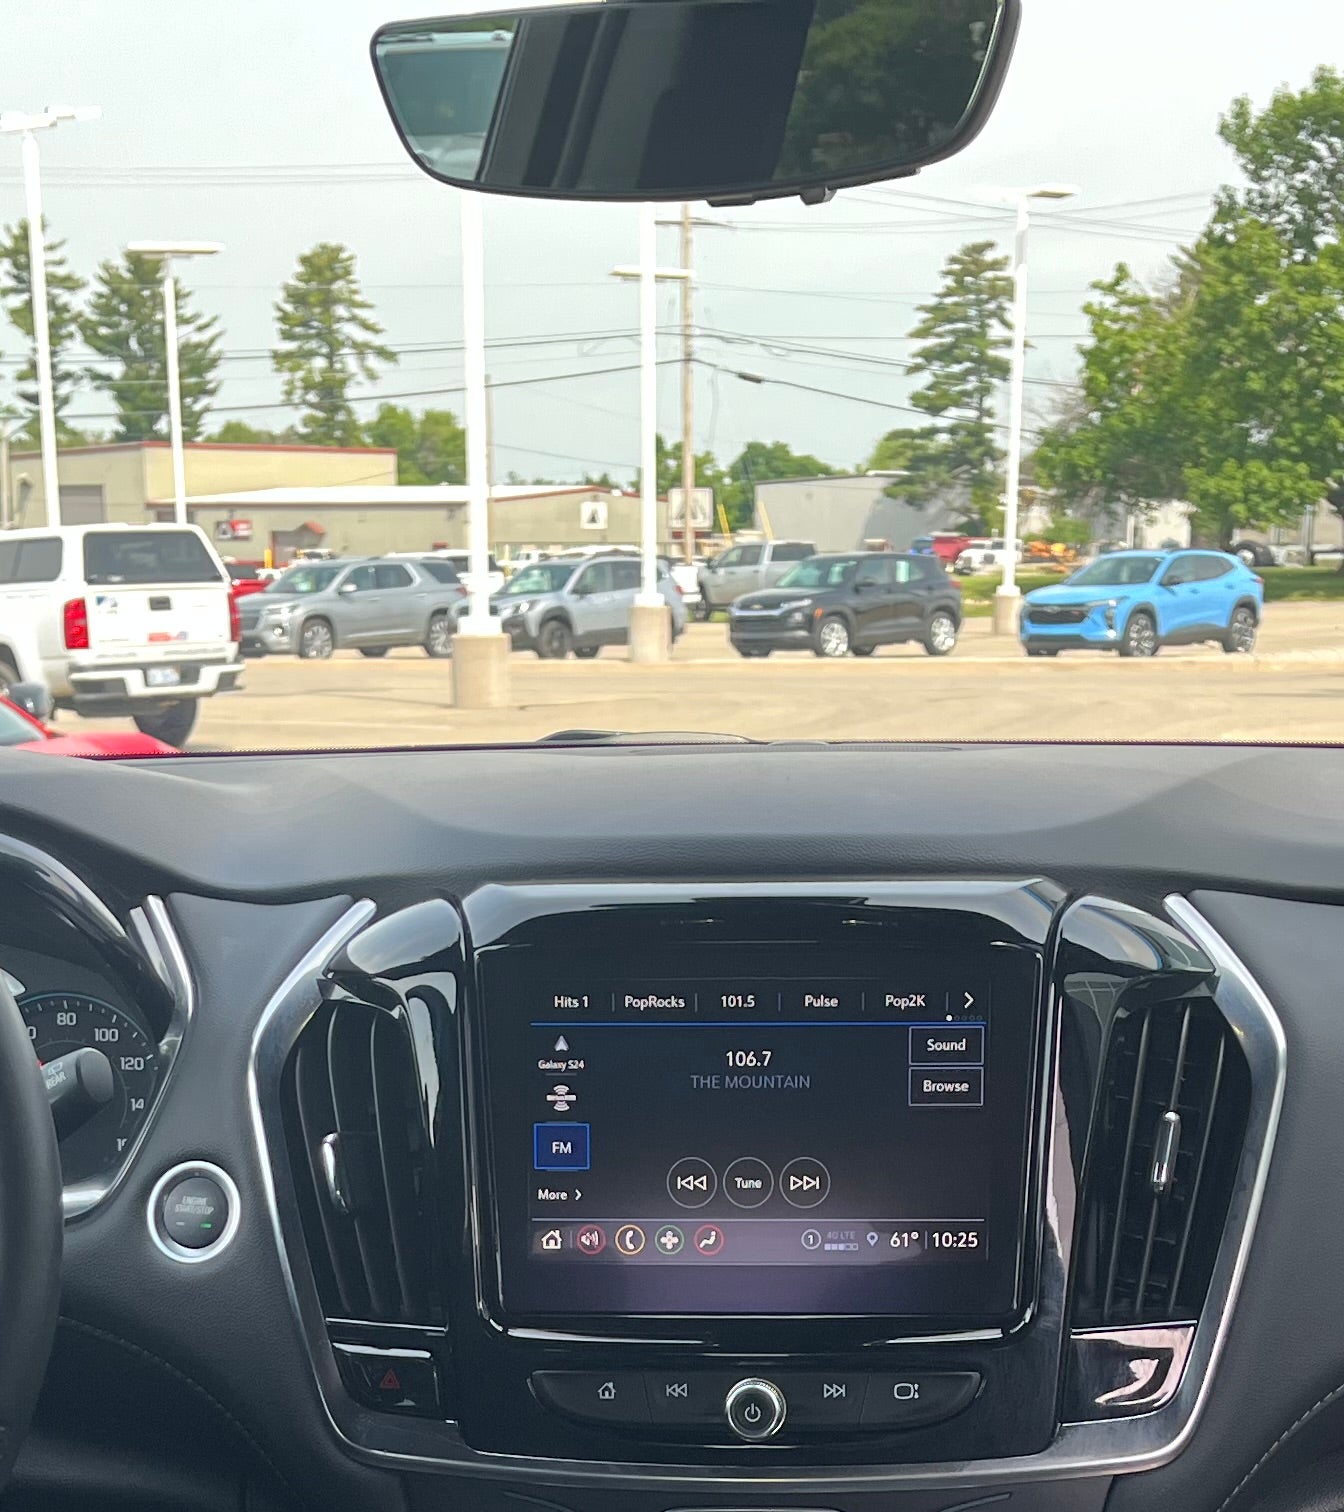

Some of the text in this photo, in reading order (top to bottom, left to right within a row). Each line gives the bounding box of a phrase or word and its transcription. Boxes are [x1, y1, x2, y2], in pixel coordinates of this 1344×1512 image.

[554, 995, 589, 1008] Hits 1
[624, 994, 685, 1011] PopRocks
[721, 995, 756, 1008] 101.5
[804, 994, 839, 1008] Pulse
[885, 994, 926, 1010] Pop2K
[56, 1012, 77, 1026] 80
[94, 1028, 119, 1042] 100
[926, 1038, 967, 1051] Sound
[120, 1057, 145, 1071] 120
[537, 1059, 585, 1072] Galaxy S24
[726, 1051, 772, 1067] 106.7
[45, 1071, 67, 1090] REAR
[690, 1075, 811, 1089] THE MOUNTAIN
[922, 1080, 970, 1093] Browse
[130, 1098, 145, 1111] 14
[552, 1142, 572, 1154] FM
[734, 1177, 762, 1189] Tune
[537, 1189, 568, 1201] More
[932, 1232, 978, 1248] 10:25
